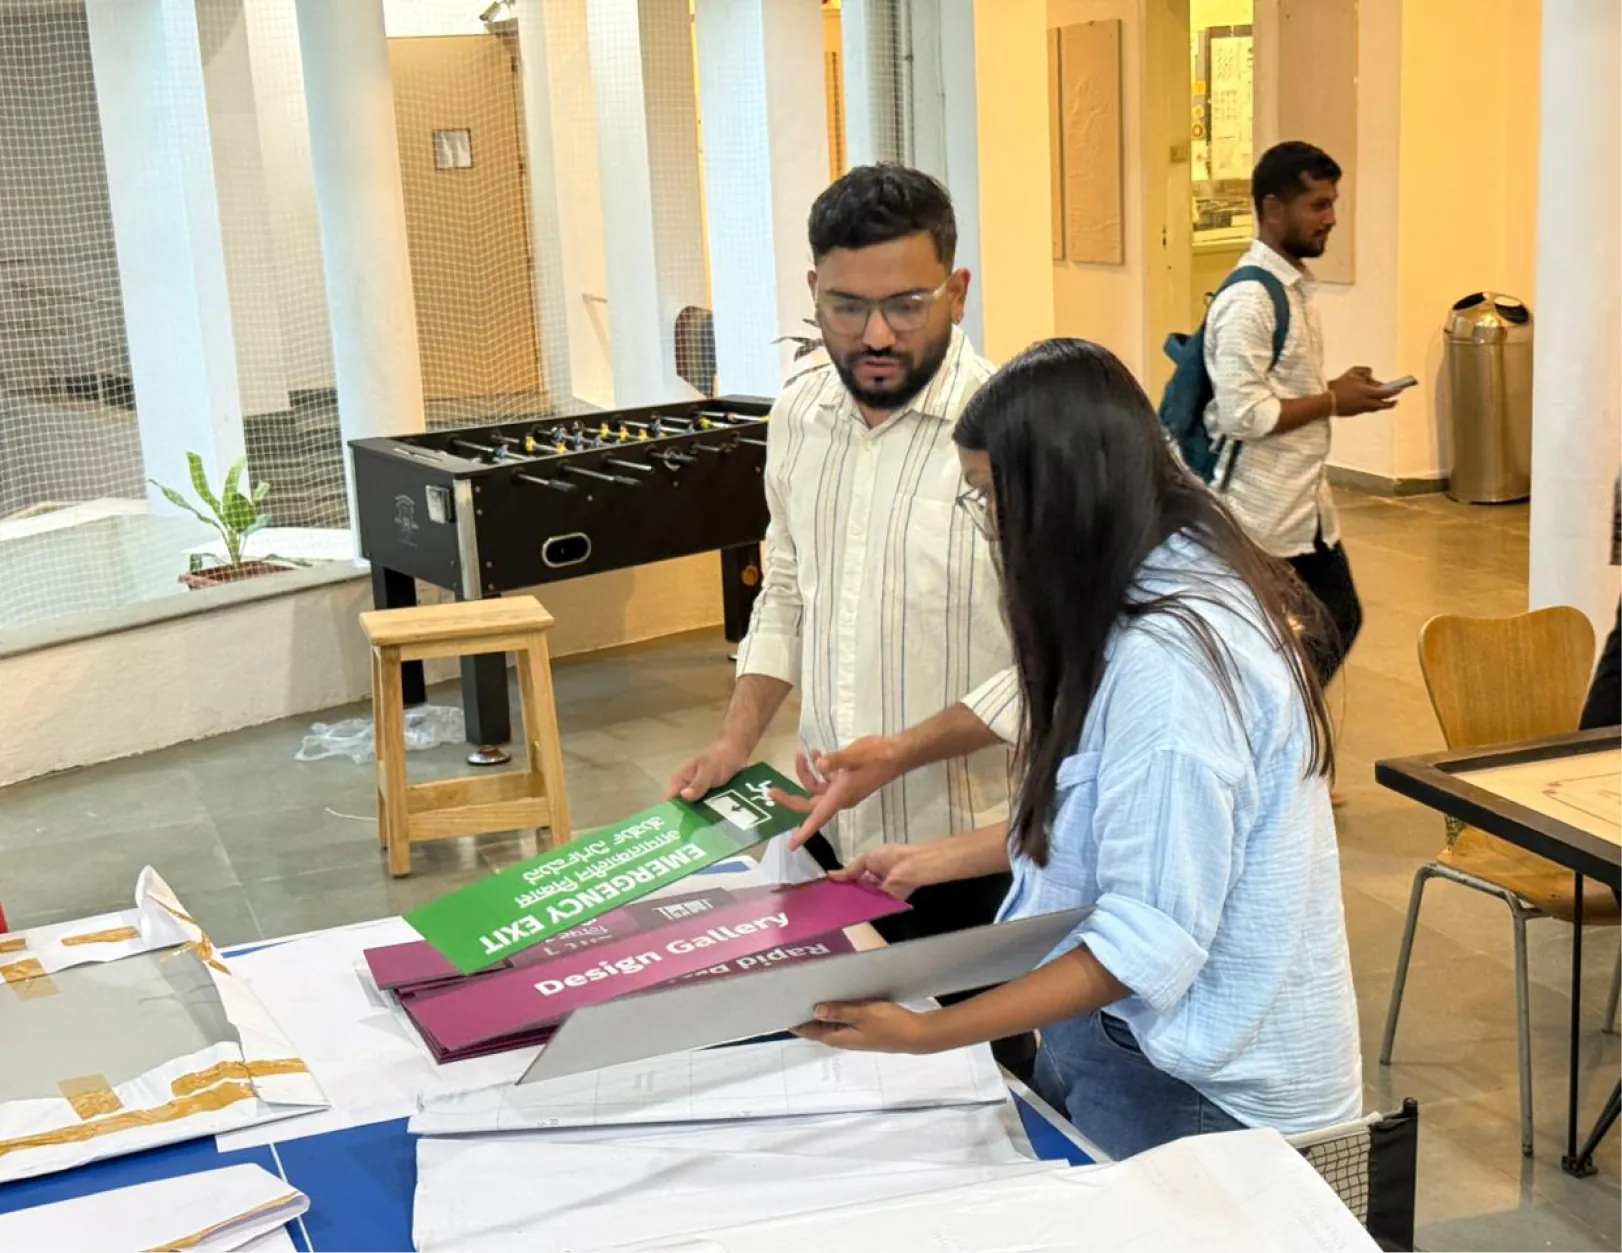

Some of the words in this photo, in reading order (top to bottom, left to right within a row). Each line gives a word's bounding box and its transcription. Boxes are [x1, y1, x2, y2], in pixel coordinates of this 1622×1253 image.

[522, 839, 611, 885] ನಿರ್ಗಮನ
[575, 830, 681, 882] आपातकालीन
[514, 876, 579, 909] निकास
[546, 842, 708, 925] EMERGENCY
[479, 914, 545, 955] EXIT
[534, 950, 663, 996] Design
[665, 912, 789, 955] Gallery
[736, 942, 831, 970] Rapid
